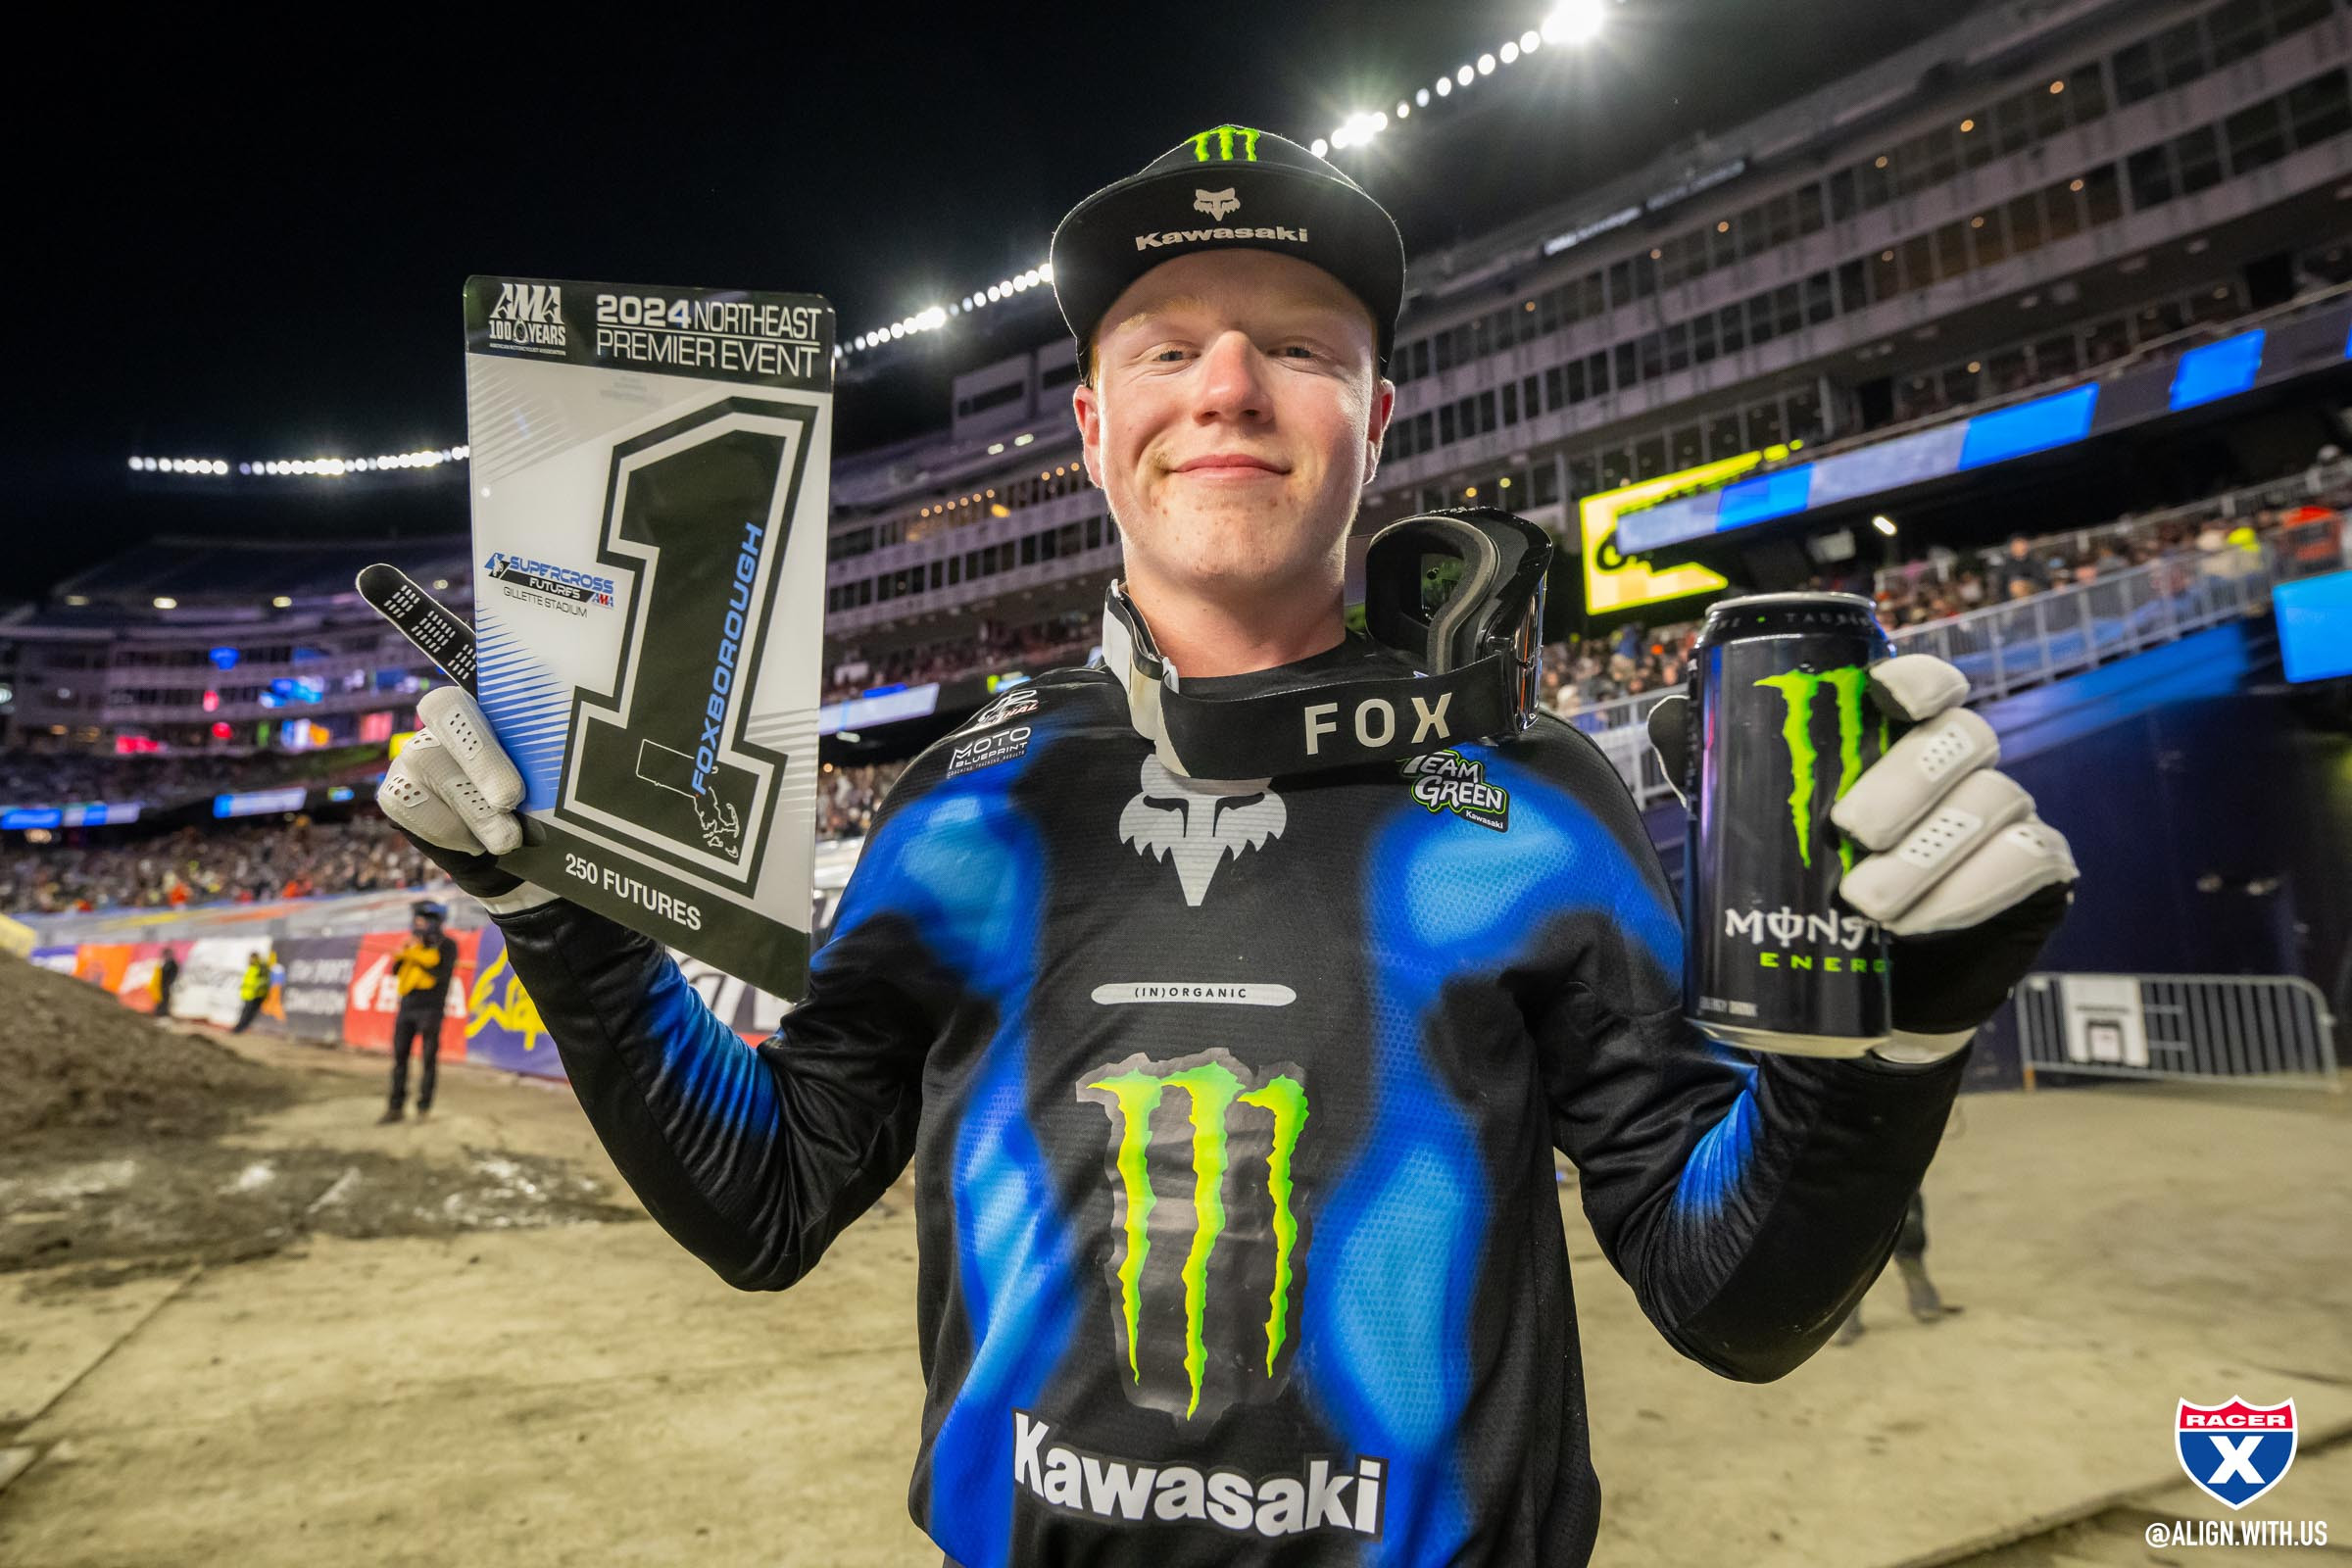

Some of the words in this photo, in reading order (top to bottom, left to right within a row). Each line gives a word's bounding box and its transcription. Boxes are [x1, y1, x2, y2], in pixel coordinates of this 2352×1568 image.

[1135, 226, 1308, 251] Kawasaki
[489, 282, 565, 324] AMA
[596, 294, 692, 328] 2024
[694, 300, 821, 340] NORTHEAST
[489, 319, 512, 341] 100
[527, 322, 565, 346] YEARS
[597, 329, 715, 368] PREMIER
[721, 340, 820, 377] EVENT
[510, 556, 614, 594] SUPERCROSS
[529, 577, 580, 600] FUTURES
[504, 586, 543, 607] GILLETTE
[544, 597, 588, 619] STADIUM
[592, 591, 614, 607] AMA
[555, 396, 818, 899] 1
[692, 522, 763, 796] FOXBOROUGH
[1303, 692, 1452, 756] FOX
[949, 726, 1031, 770] MOTO
[956, 741, 1028, 768] BLUEPRINT
[1403, 751, 1479, 784] TEAM
[1415, 775, 1502, 808] GREEN
[1465, 809, 1504, 830] Kawasaki
[565, 853, 599, 885] 250
[603, 867, 702, 931] FUTURES
[1759, 952, 1891, 973] ENERG
[1135, 986, 1247, 1000] (IN)ORGANIC
[1014, 1412, 1381, 1537] Kawasaki
